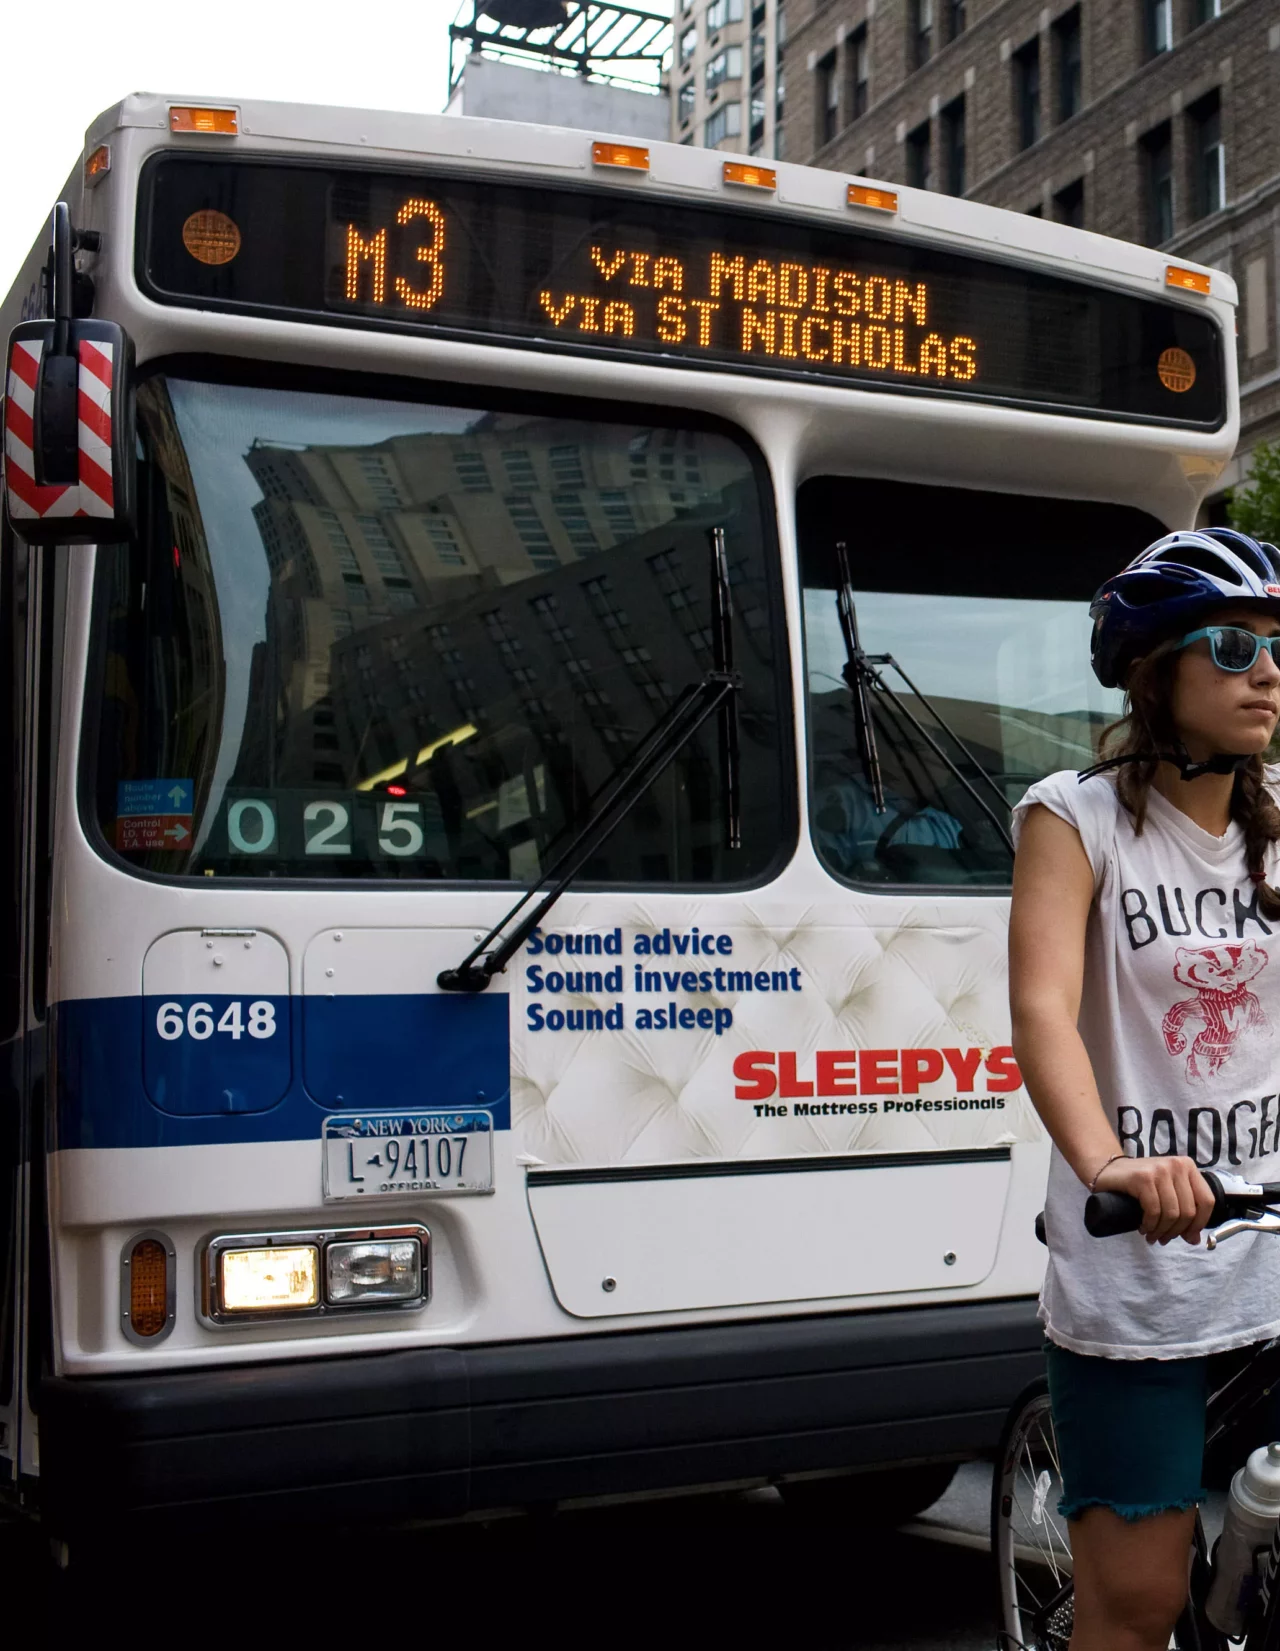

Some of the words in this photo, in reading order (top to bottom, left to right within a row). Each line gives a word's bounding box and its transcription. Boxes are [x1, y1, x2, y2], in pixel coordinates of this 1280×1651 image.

[346, 199, 445, 309] M3
[591, 246, 683, 291] VIA
[710, 252, 926, 326] MADISON
[540, 291, 634, 336] VIA
[657, 296, 720, 346] ST
[742, 307, 977, 380] NICHOLAS
[124, 783, 154, 793] Route
[124, 793, 162, 802] number
[123, 819, 161, 829] Control
[142, 828, 158, 838] for
[145, 840, 165, 848] use
[527, 927, 622, 956] Sound
[634, 928, 733, 956] advice
[526, 965, 623, 993] Sound
[634, 964, 802, 993] investment
[156, 1000, 276, 1041] 6648
[527, 1003, 624, 1032] Sound
[635, 1003, 733, 1036] asleep
[753, 1103, 787, 1118] The
[793, 1099, 880, 1117] Mattress
[883, 1097, 1006, 1114] Professionals
[366, 1119, 404, 1136] NEW
[410, 1116, 453, 1134] YORK
[380, 1181, 441, 1192] OFFICIAL
